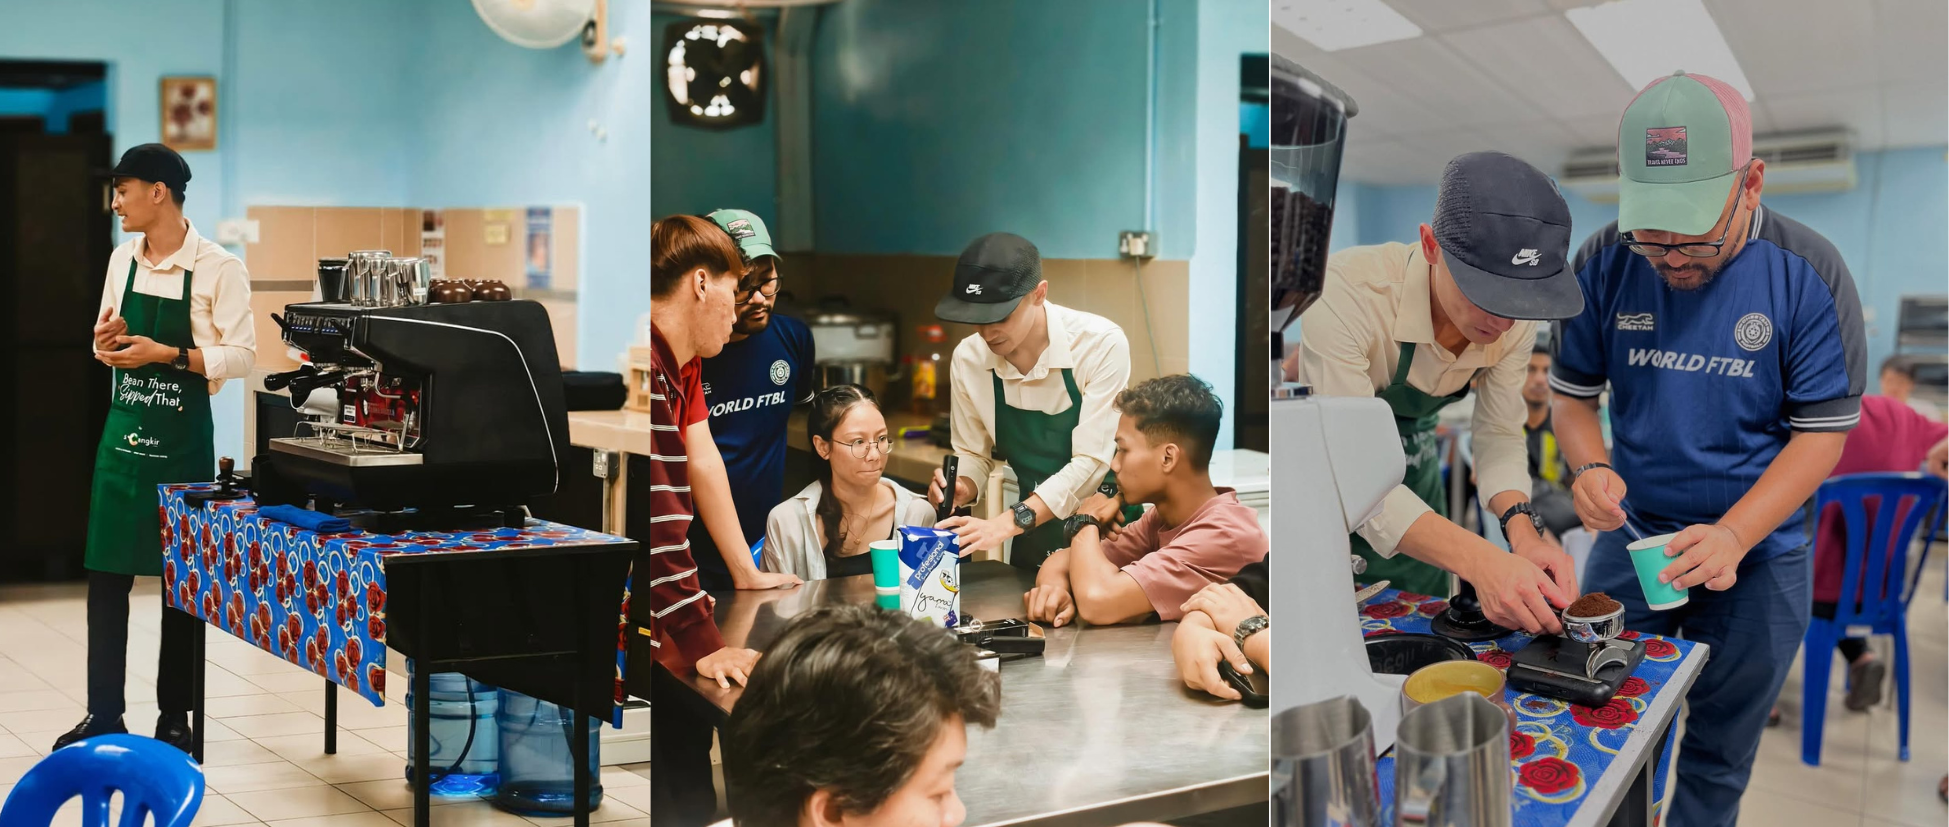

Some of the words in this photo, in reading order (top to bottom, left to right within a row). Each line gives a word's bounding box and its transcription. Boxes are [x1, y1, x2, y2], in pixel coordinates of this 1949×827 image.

[1628, 348, 1706, 372] WORLD
[1705, 356, 1755, 378] FTBL
[122, 372, 144, 388] Bean
[147, 377, 182, 394] There,
[119, 383, 158, 407] Sipped
[756, 390, 786, 409] FTBL
